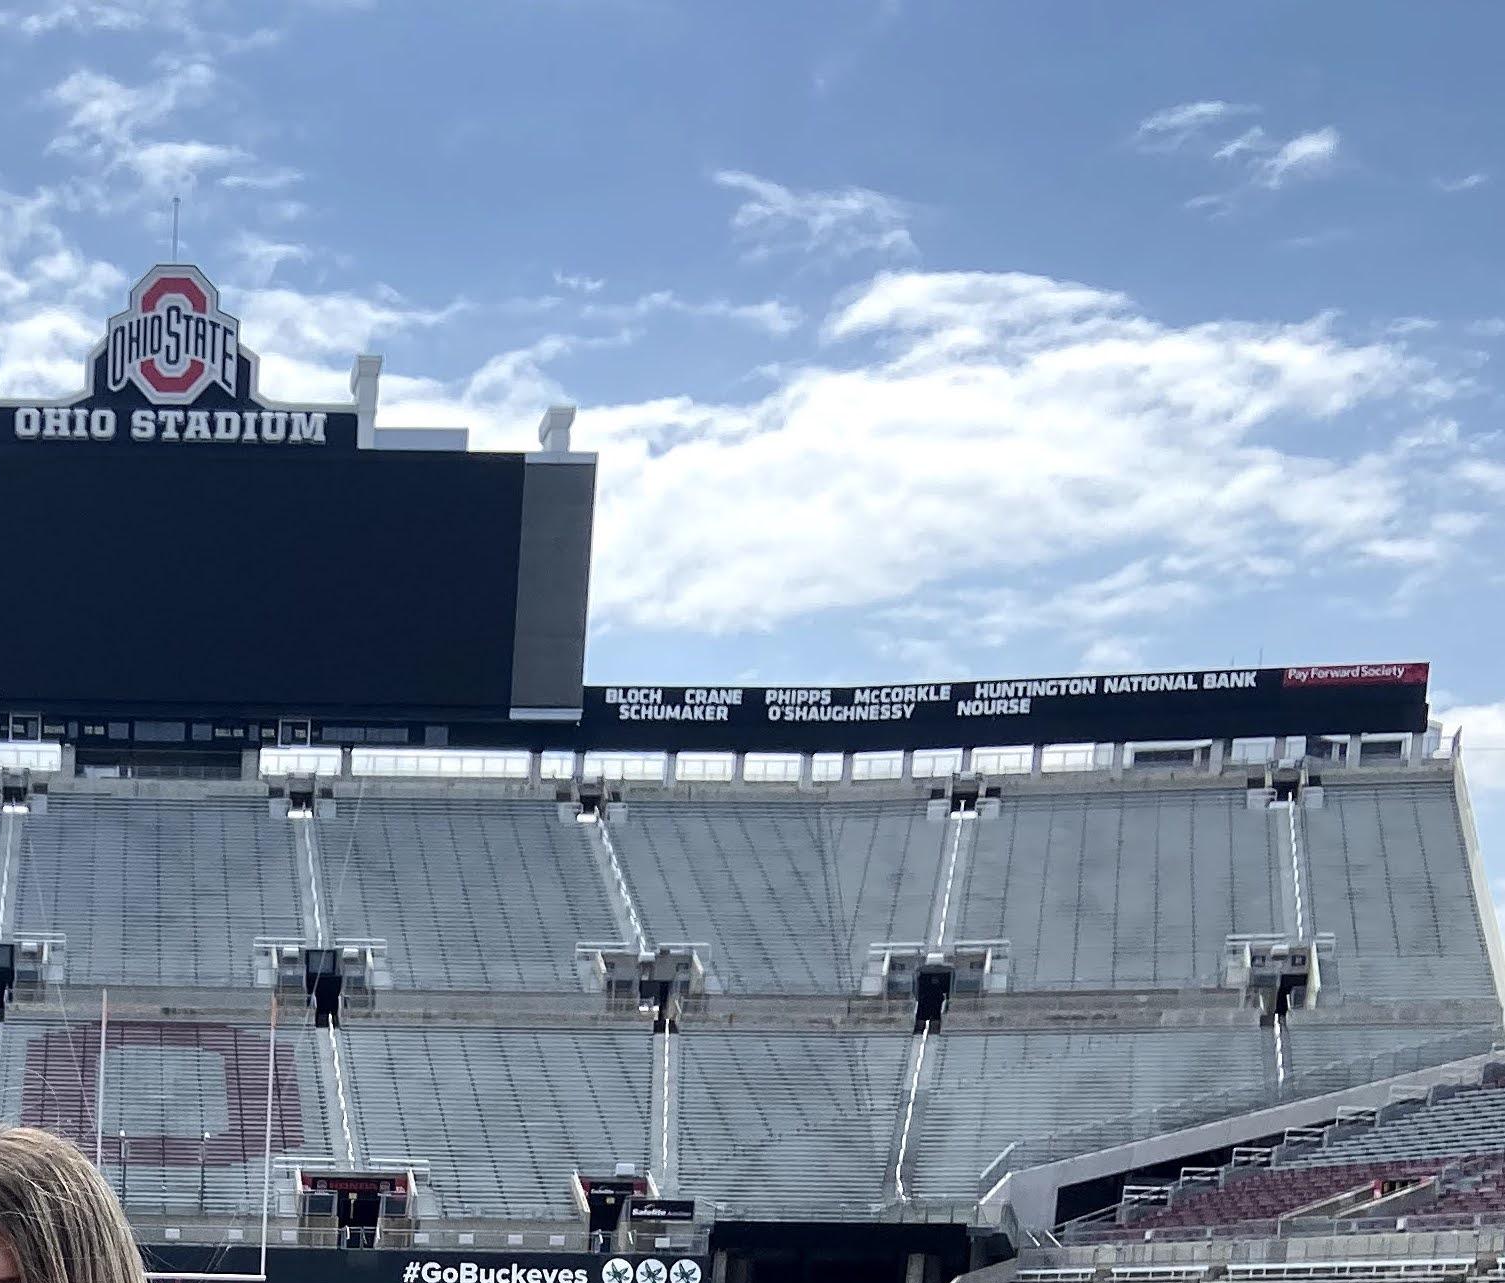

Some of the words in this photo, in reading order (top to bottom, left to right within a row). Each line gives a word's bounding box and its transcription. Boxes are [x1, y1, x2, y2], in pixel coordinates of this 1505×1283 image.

[111, 314, 163, 388] OHIO
[165, 304, 236, 390] STATE
[14, 407, 117, 440] OHIO
[130, 410, 327, 445] STADIUM
[1288, 668, 1309, 682] Pay
[1311, 666, 1360, 679] Forward
[1361, 665, 1405, 678] Society
[854, 685, 951, 704] McCORKLE
[974, 678, 1096, 699] HUNTINGTON
[1103, 674, 1198, 694] NATIONAL
[1202, 671, 1257, 690] BANK
[605, 688, 663, 704] BLOCH
[684, 689, 743, 705] CRANE
[765, 689, 832, 705] PHIPPS
[618, 704, 729, 721] SCHUMAKER
[767, 703, 916, 722] O'SHAUGHNESSY
[956, 698, 1031, 717] NOURSE
